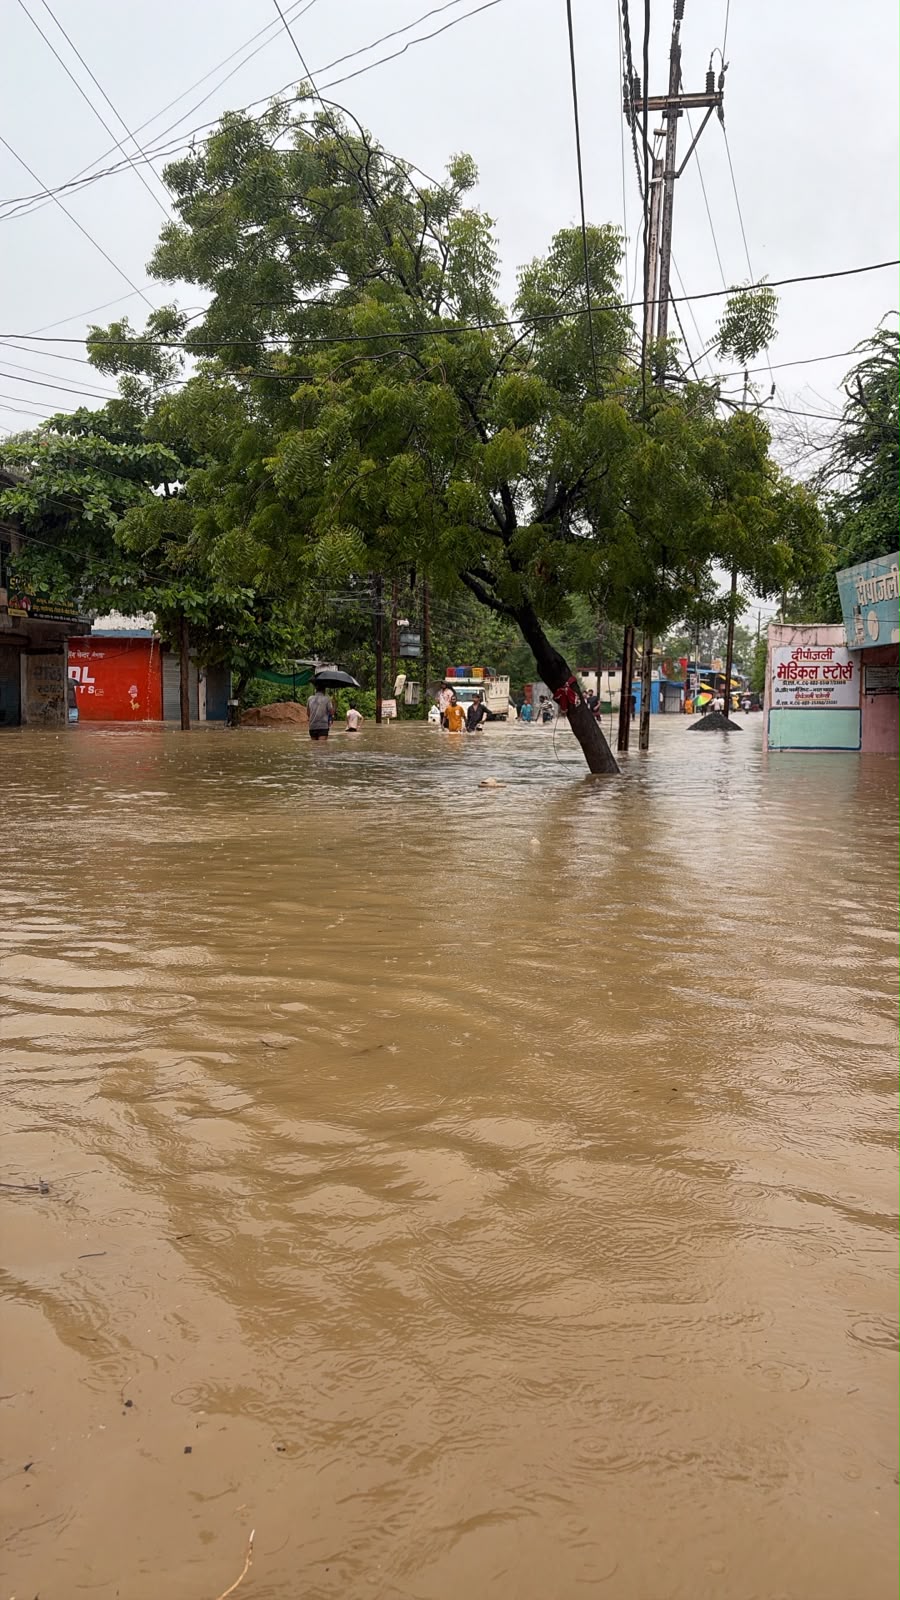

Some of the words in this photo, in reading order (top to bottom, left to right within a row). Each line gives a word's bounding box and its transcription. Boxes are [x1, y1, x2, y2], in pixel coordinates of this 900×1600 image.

[856, 563, 900, 606] दीपांजली
[791, 647, 835, 661] दीपांजली
[777, 661, 820, 680] मेडिकल
[822, 661, 854, 680] स्टोर्स
